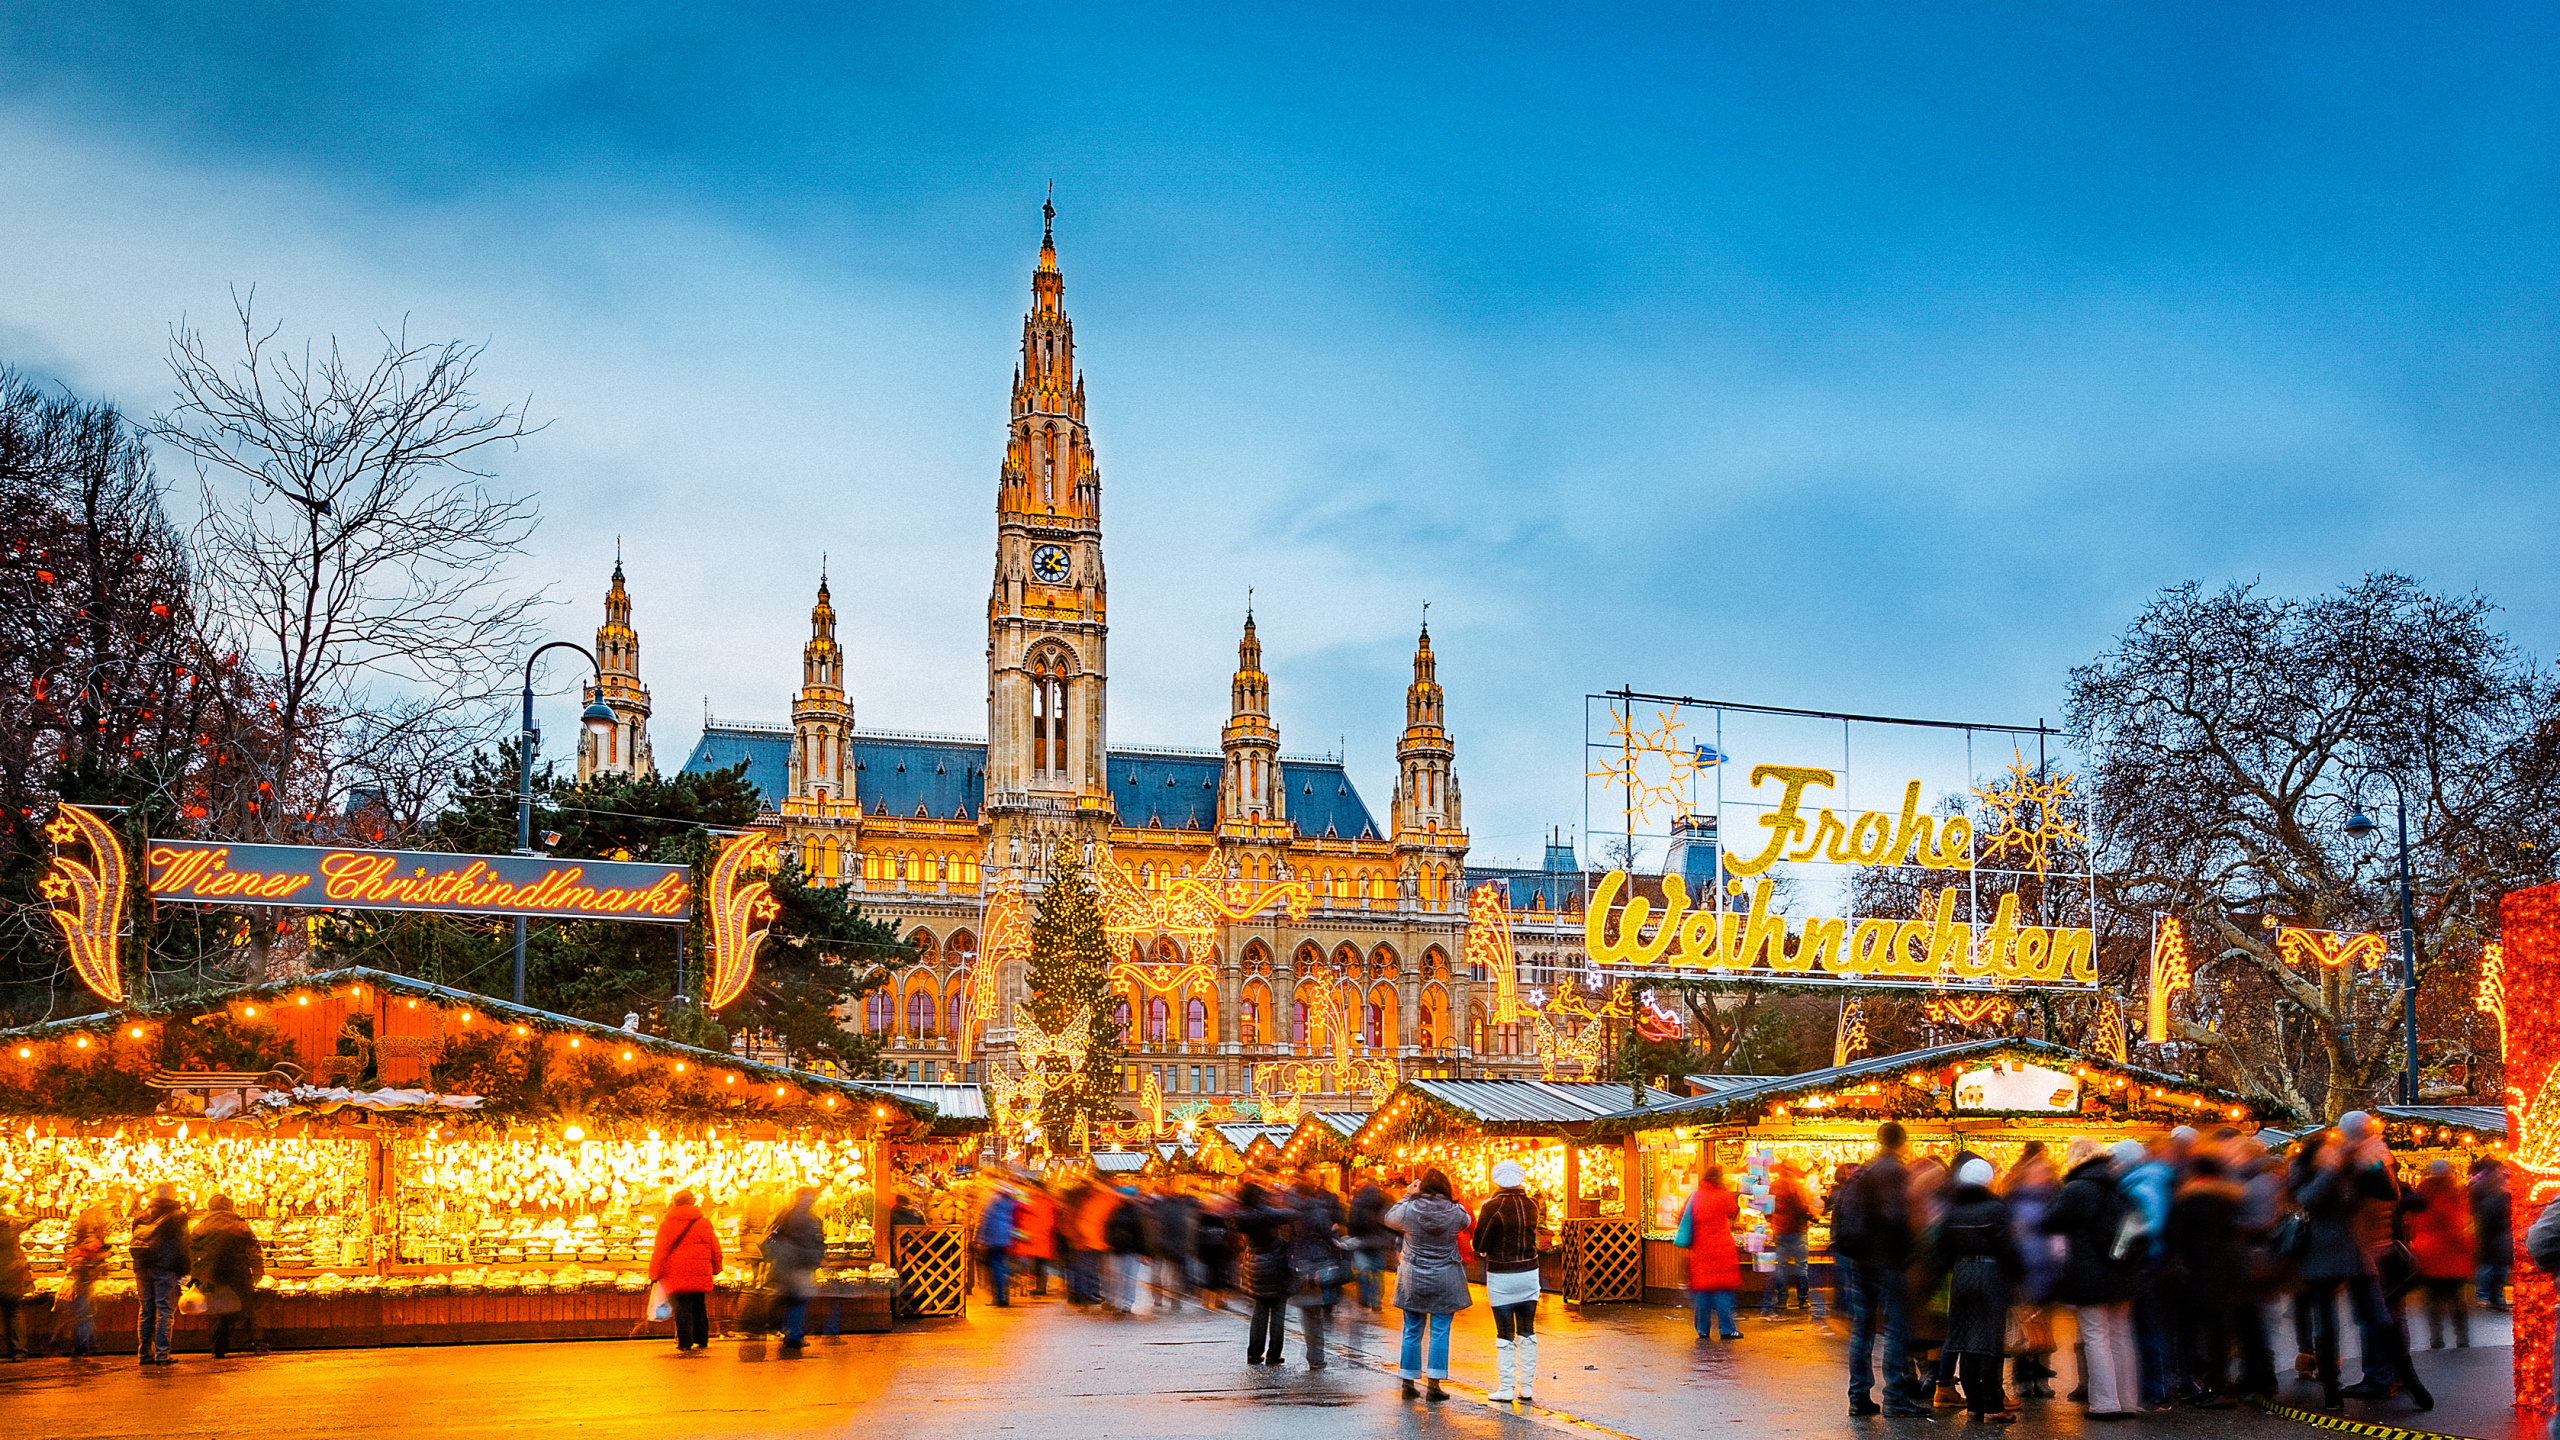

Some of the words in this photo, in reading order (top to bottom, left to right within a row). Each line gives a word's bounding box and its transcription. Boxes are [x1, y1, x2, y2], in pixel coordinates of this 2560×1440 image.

[1723, 764, 1973, 876] Frohe
[149, 848, 310, 895] Wiener
[321, 853, 688, 914] Christkindlmarkt
[1586, 869, 2098, 981] Weihnachten
